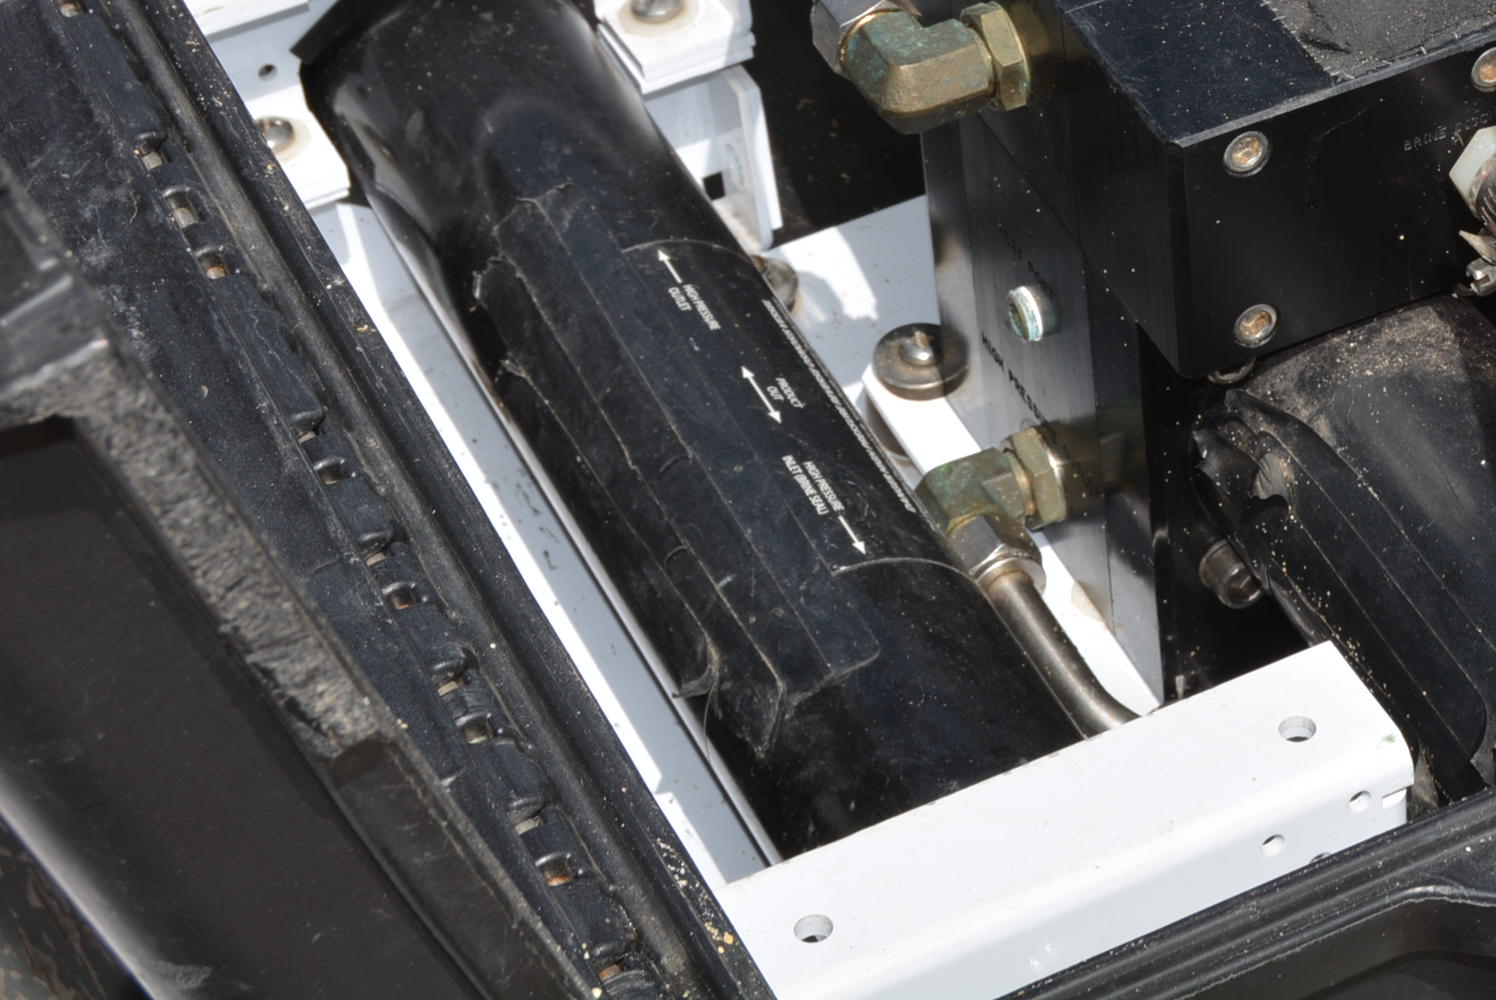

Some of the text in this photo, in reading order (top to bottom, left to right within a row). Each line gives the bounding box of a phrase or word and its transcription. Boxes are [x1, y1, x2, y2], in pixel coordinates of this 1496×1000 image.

[1403, 125, 1447, 153] BRINE
[668, 287, 692, 311] OUTLET
[766, 385, 785, 402] OUT
[775, 377, 806, 409] PRODUCT
[782, 454, 803, 475] INLET
[803, 460, 846, 512] HIGH PRESSURE
